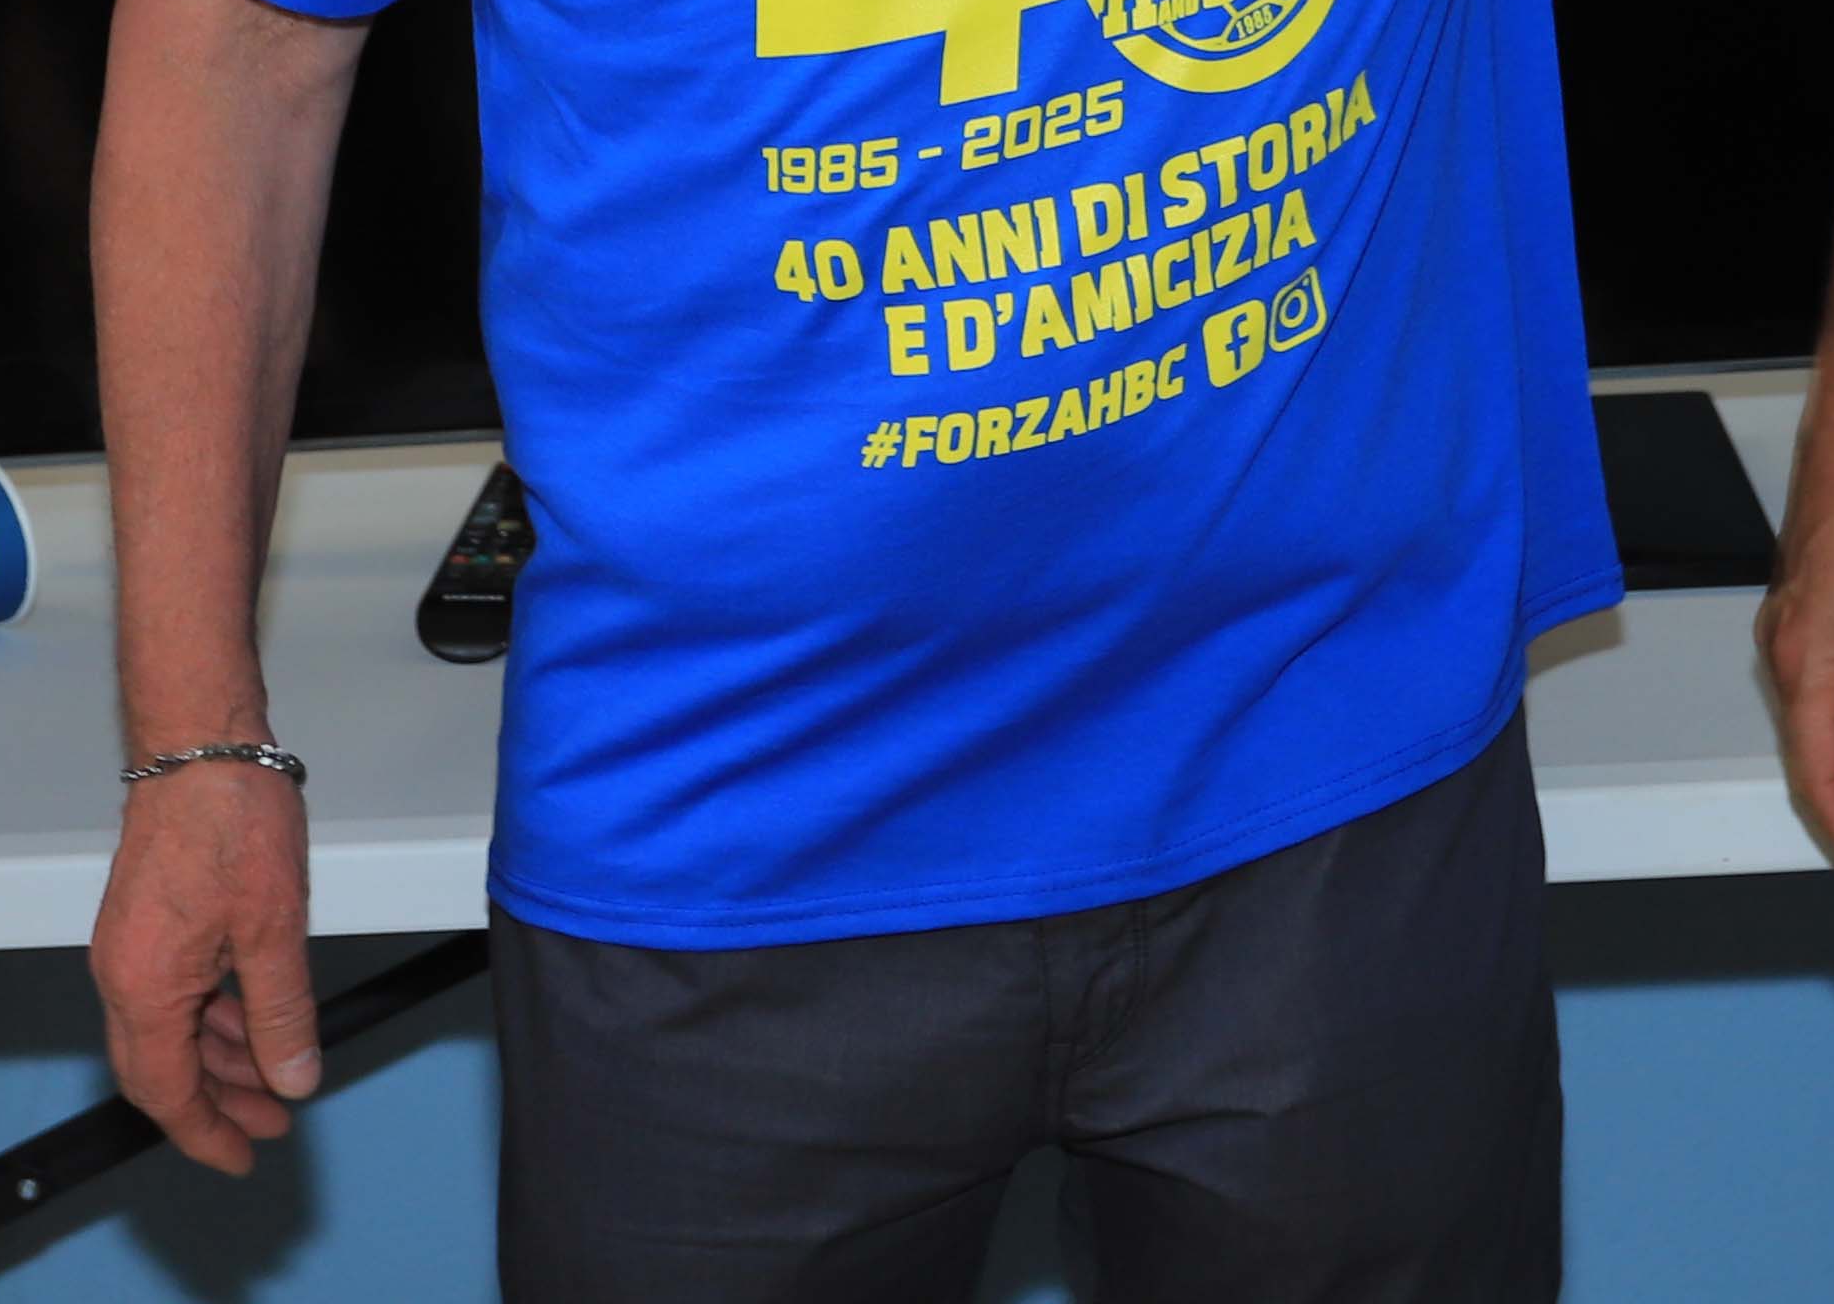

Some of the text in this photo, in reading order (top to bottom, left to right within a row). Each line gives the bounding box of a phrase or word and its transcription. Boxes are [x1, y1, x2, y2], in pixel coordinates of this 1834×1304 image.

[1235, 4, 1274, 40] 1985
[763, 138, 898, 193] 1985
[963, 81, 1124, 170] 2025
[775, 70, 1377, 301] 40 ANNI DI STORIA
[884, 188, 1316, 376] E D'AMICIZIA
[861, 345, 1187, 468] #FORZAHBC
